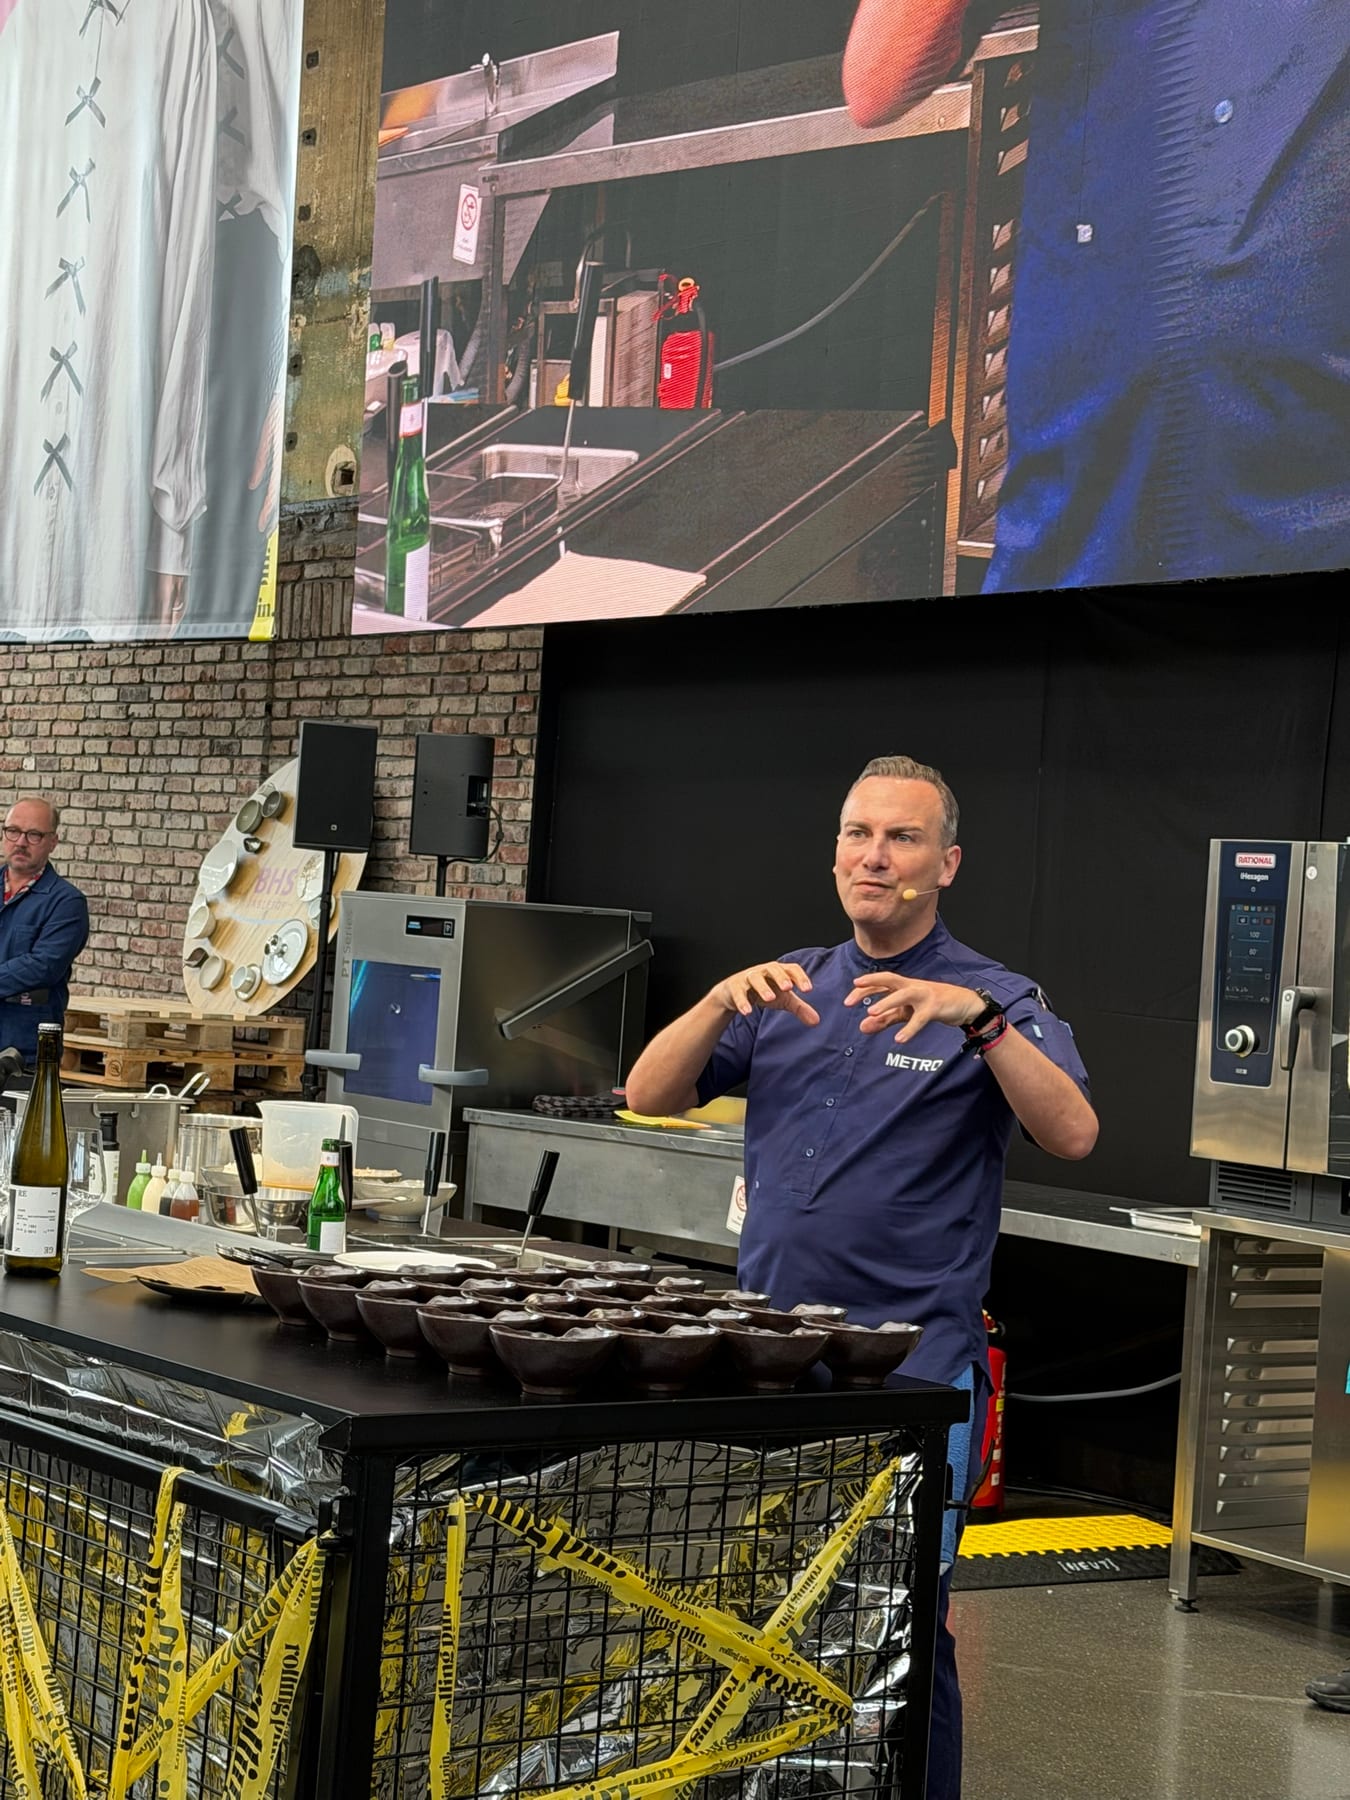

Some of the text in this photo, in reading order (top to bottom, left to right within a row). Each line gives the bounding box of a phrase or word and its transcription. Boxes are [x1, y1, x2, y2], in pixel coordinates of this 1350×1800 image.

[1238, 856, 1273, 865] RATIONAL
[254, 864, 298, 896] BHS
[341, 958, 350, 978] PT
[885, 1052, 944, 1072] METRO
[677, 1624, 709, 1650] pin.
[438, 1602, 455, 1725] rolling pin.
[270, 1642, 301, 1717] rolling
[688, 1675, 740, 1748] rolling
